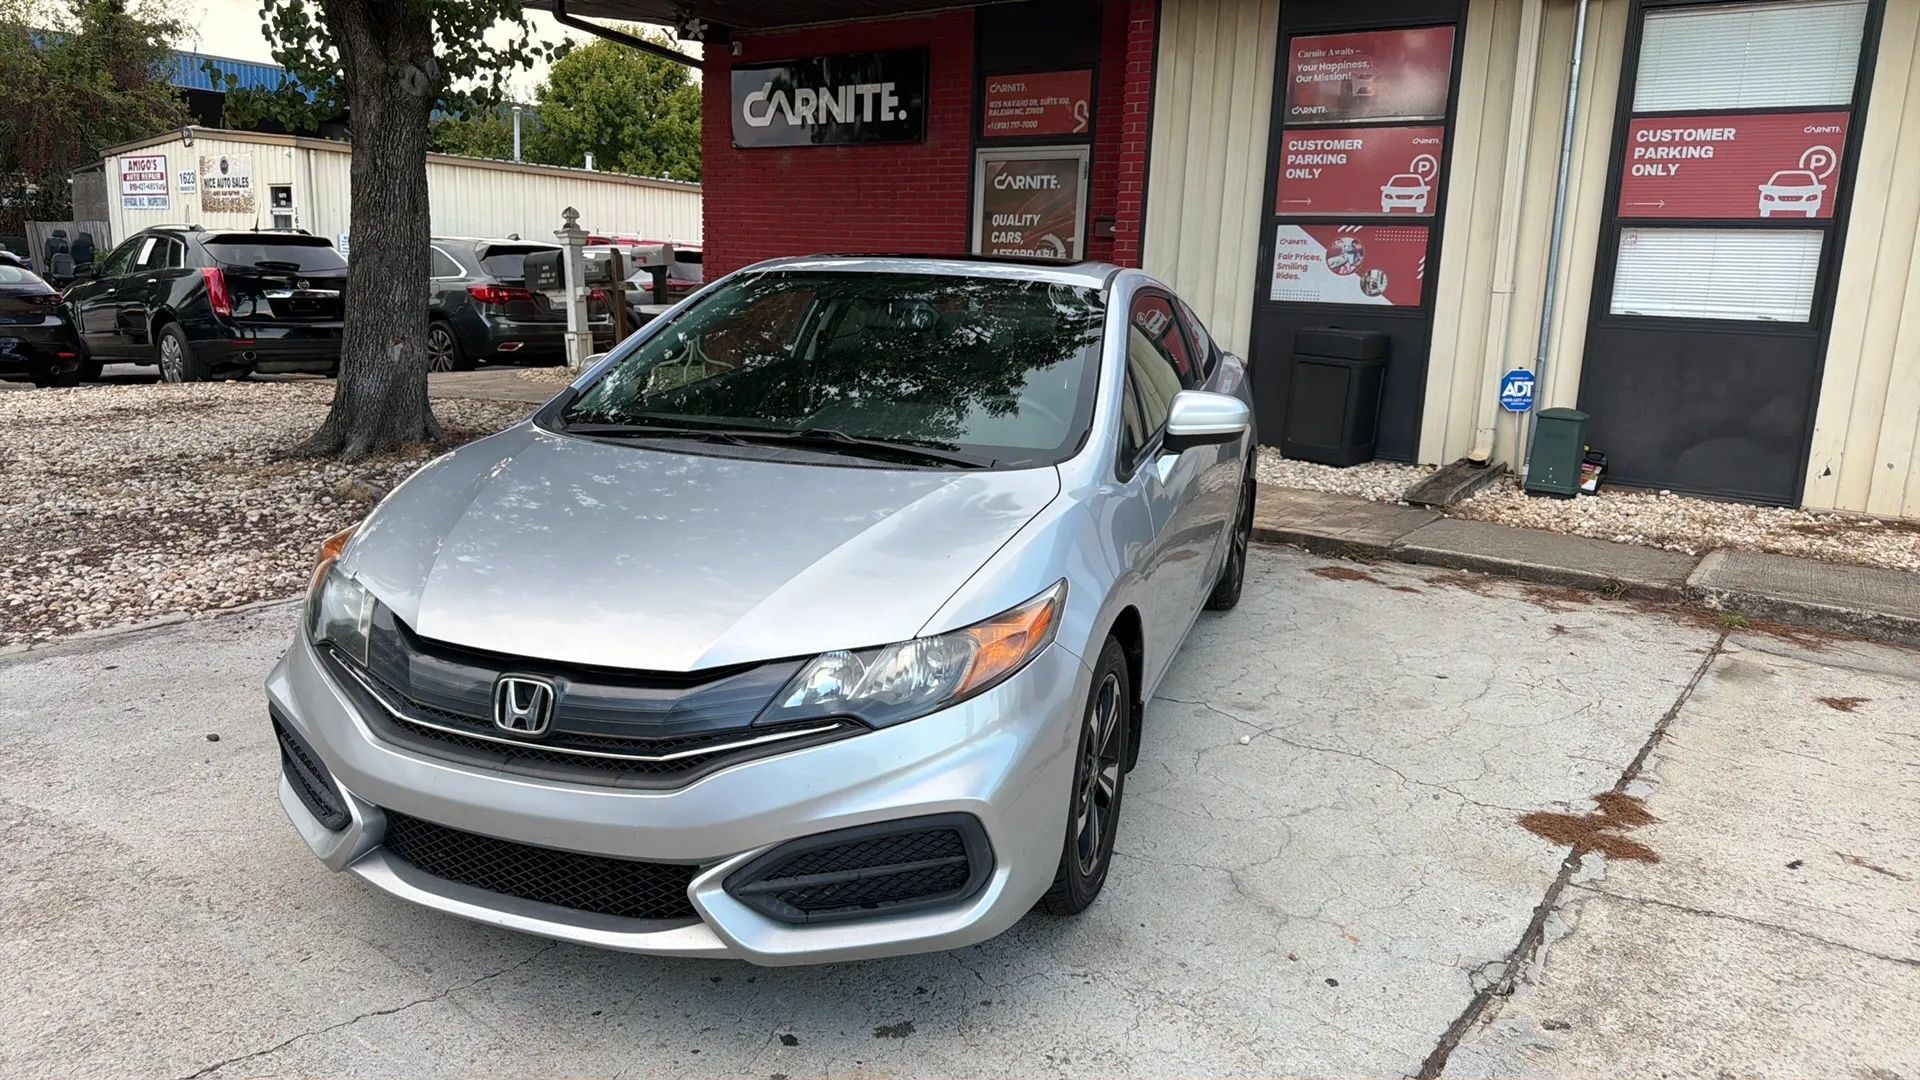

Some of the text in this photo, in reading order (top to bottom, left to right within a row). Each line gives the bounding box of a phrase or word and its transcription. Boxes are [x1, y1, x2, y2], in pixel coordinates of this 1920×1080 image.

[1298, 49, 1327, 58] Carnite
[1327, 48, 1354, 57] Awaits
[1297, 60, 1370, 73] Your Happiness,
[1295, 72, 1352, 83] Our Mission!
[743, 82, 907, 127] CARNITE.
[1636, 127, 1736, 142] CUSTOMER
[1288, 139, 1364, 151] CUSTOMER
[1287, 154, 1347, 165] PARKING
[1633, 146, 1714, 160] PARKING
[128, 159, 158, 171] AMIGO'S
[1631, 163, 1680, 176] ONLY
[179, 171, 196, 185] 1623
[1285, 168, 1322, 179] ONLY
[203, 178, 217, 189] NICE
[217, 177, 231, 188] AUTO
[231, 176, 249, 188] SALES
[994, 172, 1061, 190] CARNITE.
[992, 213, 1041, 227] QUALITY
[991, 231, 1024, 245] CARS,
[1278, 252, 1322, 262] Fair Prices,
[1277, 262, 1308, 273] Smiling
[1276, 272, 1301, 280] Rides.
[1502, 381, 1535, 397] ADT
